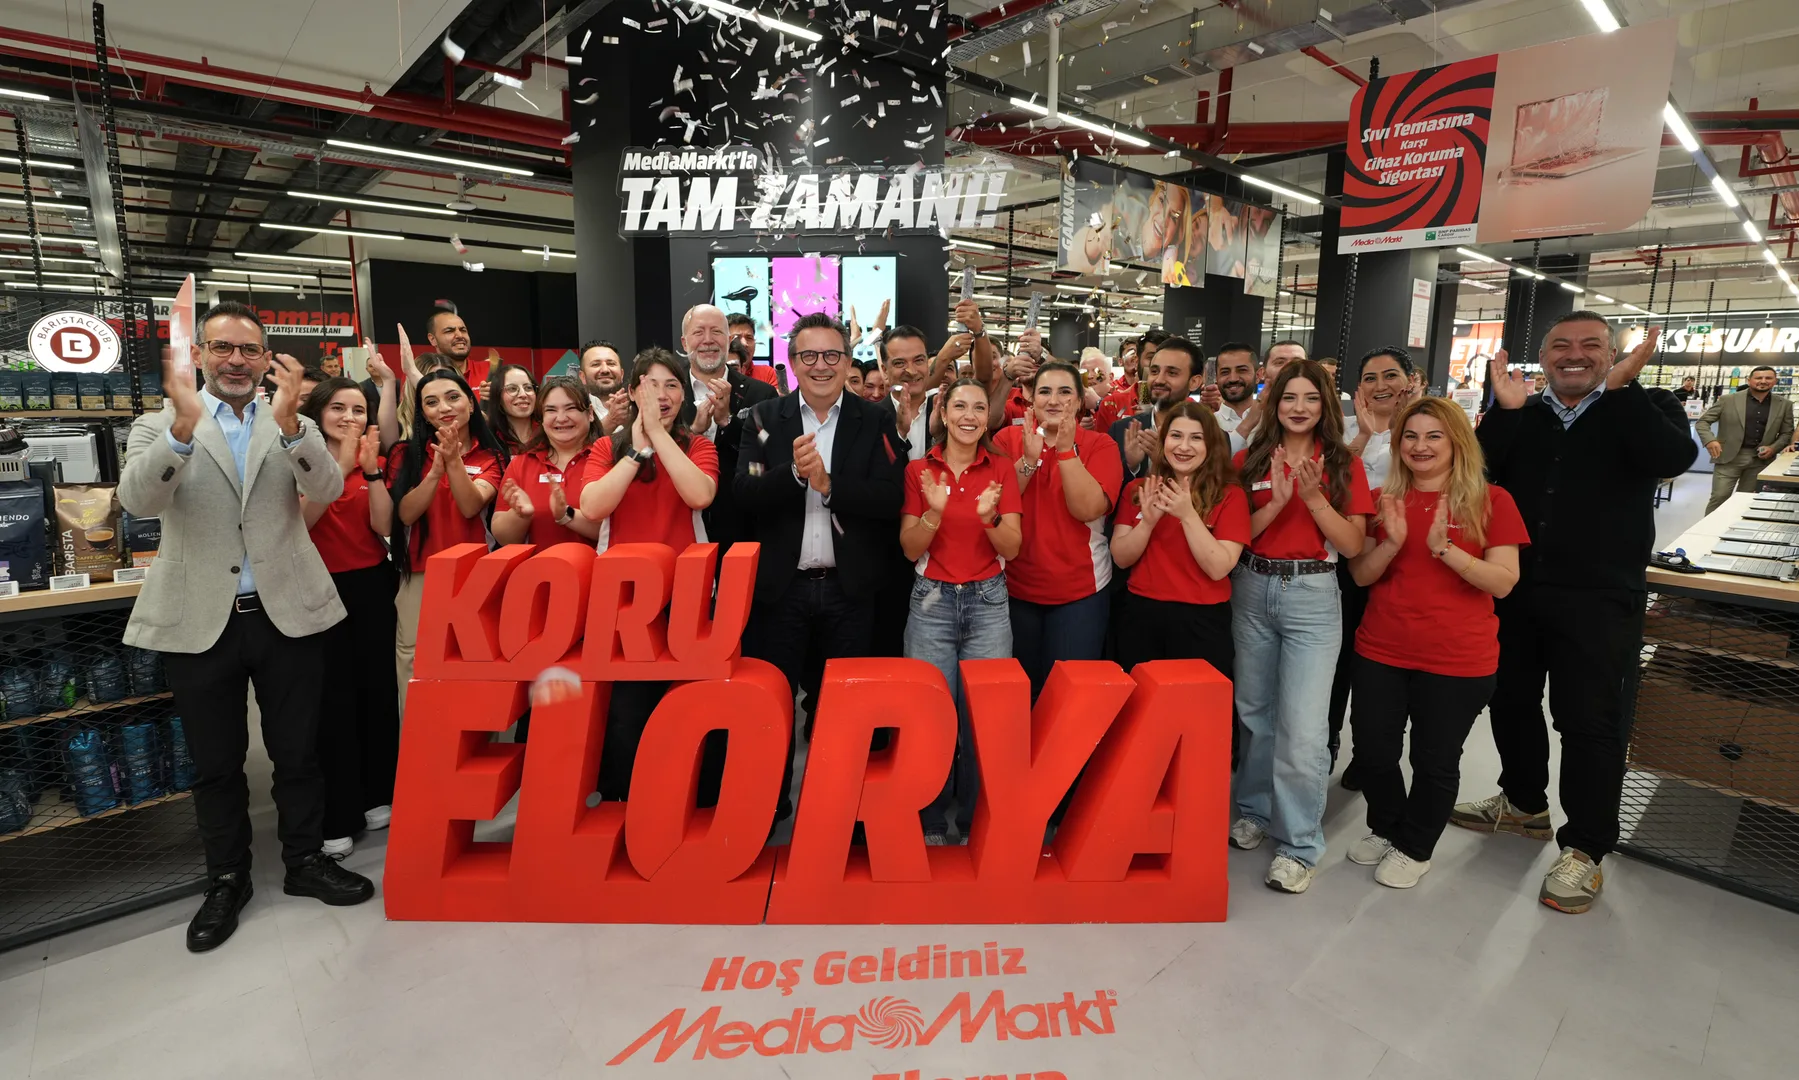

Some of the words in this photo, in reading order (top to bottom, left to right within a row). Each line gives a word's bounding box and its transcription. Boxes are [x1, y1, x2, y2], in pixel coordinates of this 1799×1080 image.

[1361, 127, 1391, 143] Sıvı
[1394, 112, 1475, 138] Temasına
[1400, 138, 1428, 151] Karşı
[623, 149, 756, 172] MediaMarkt'la
[1364, 156, 1402, 172] Cihaz
[1403, 147, 1465, 166] Koruma
[1378, 165, 1446, 186] Sigortası
[621, 176, 739, 232] TAM
[749, 171, 1007, 230] ZAMANI!
[1351, 239, 1375, 247] Media
[1380, 236, 1403, 244] Markt
[109, 303, 170, 316] KAAAR
[37, 316, 112, 343] BARISTACLUB
[272, 325, 293, 335] SATIŞI
[295, 325, 319, 333] TESLİM
[320, 326, 341, 334] ALANI
[0, 514, 30, 522] IENDO
[61, 529, 76, 576] BARISTA
[414, 542, 761, 664] KORU
[392, 657, 1233, 884] FLORYA
[700, 954, 803, 997] Hoş
[813, 941, 1027, 985] Geldiniz
[605, 1006, 856, 1066] Media
